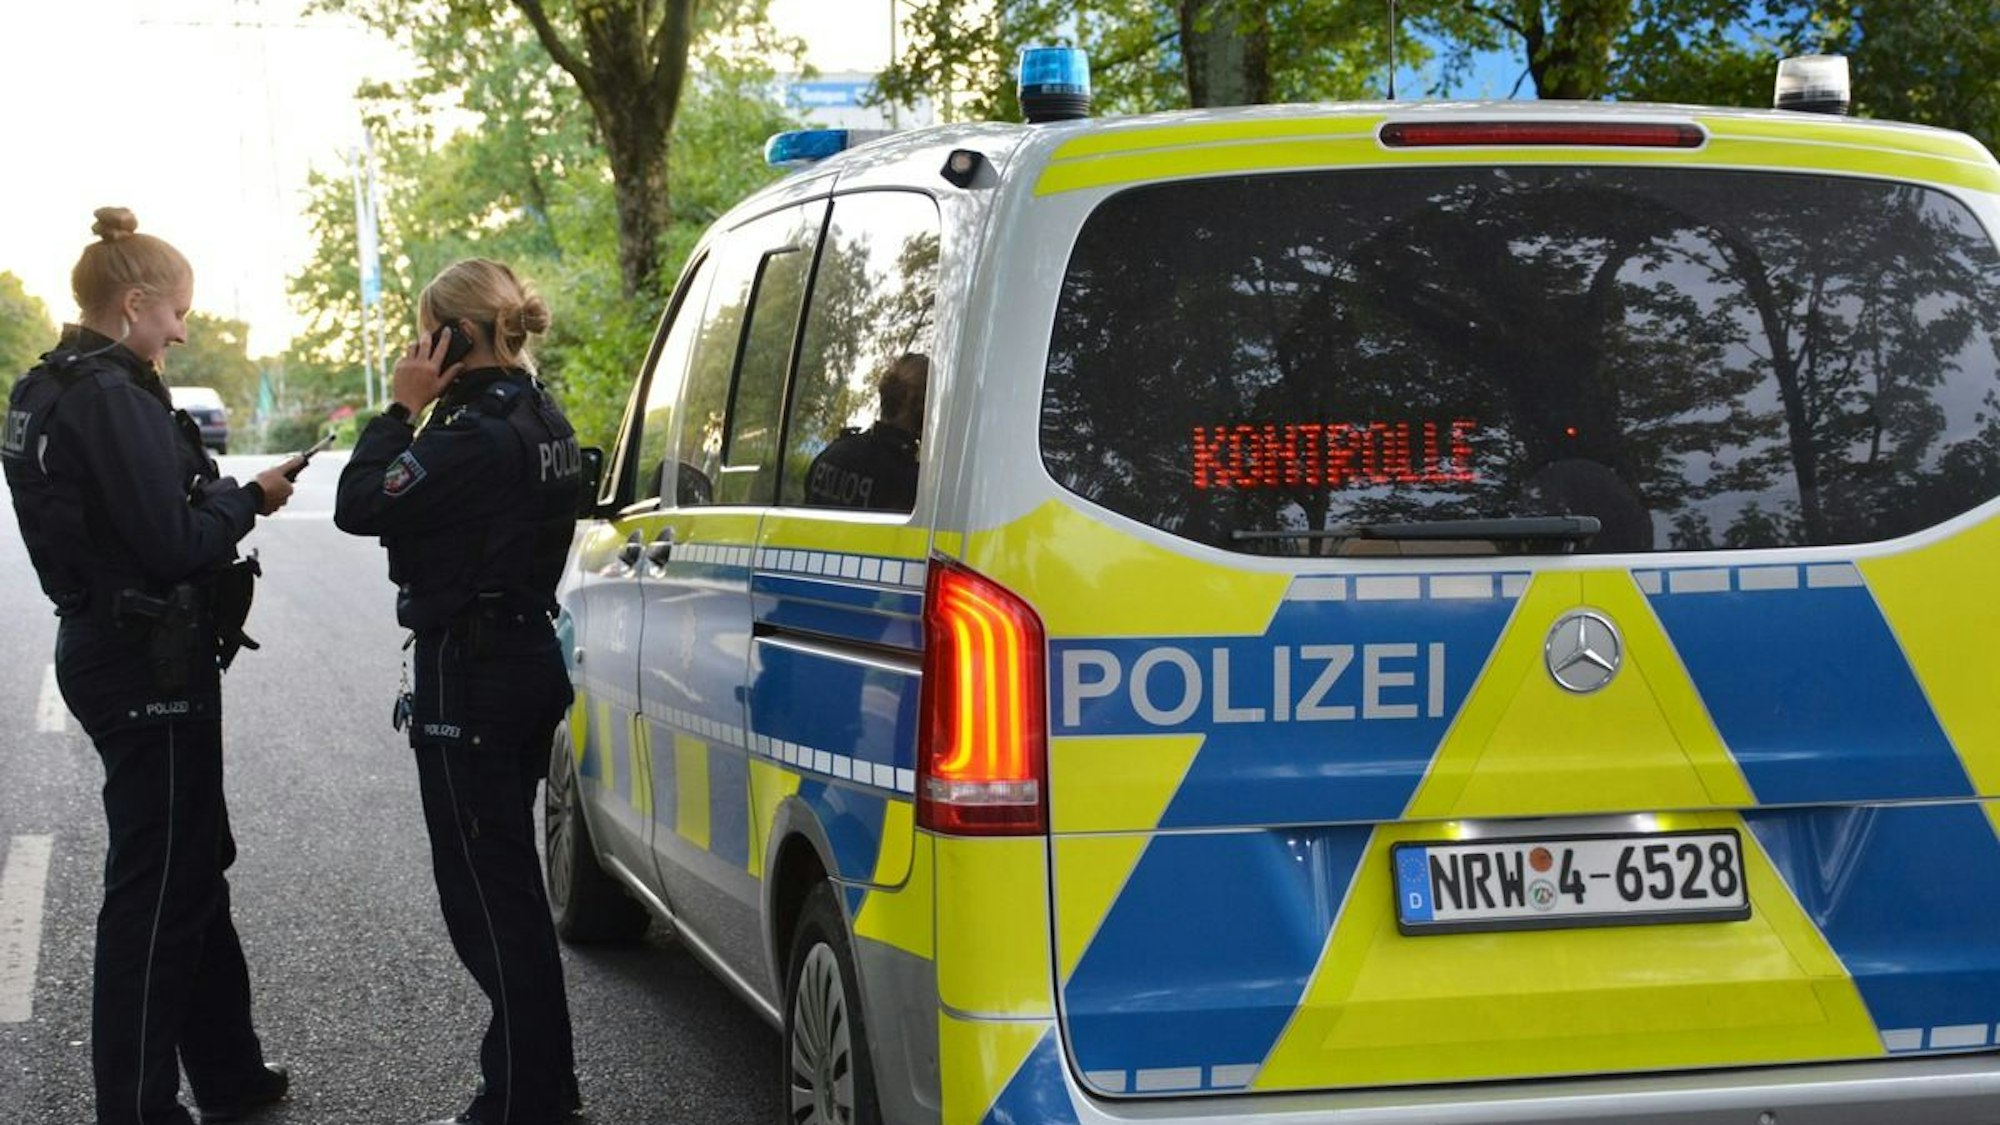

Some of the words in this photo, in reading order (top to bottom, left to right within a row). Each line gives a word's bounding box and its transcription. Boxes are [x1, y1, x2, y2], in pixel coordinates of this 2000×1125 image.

[1194, 418, 1477, 489] KONTROLLE
[146, 701, 190, 716] POLIZEI
[1062, 642, 1445, 727] POLIZEI
[424, 724, 461, 738] POLIZEI
[1409, 892, 1423, 909] D
[1429, 851, 1526, 911] NRW
[1559, 842, 1738, 904] 4-6528
